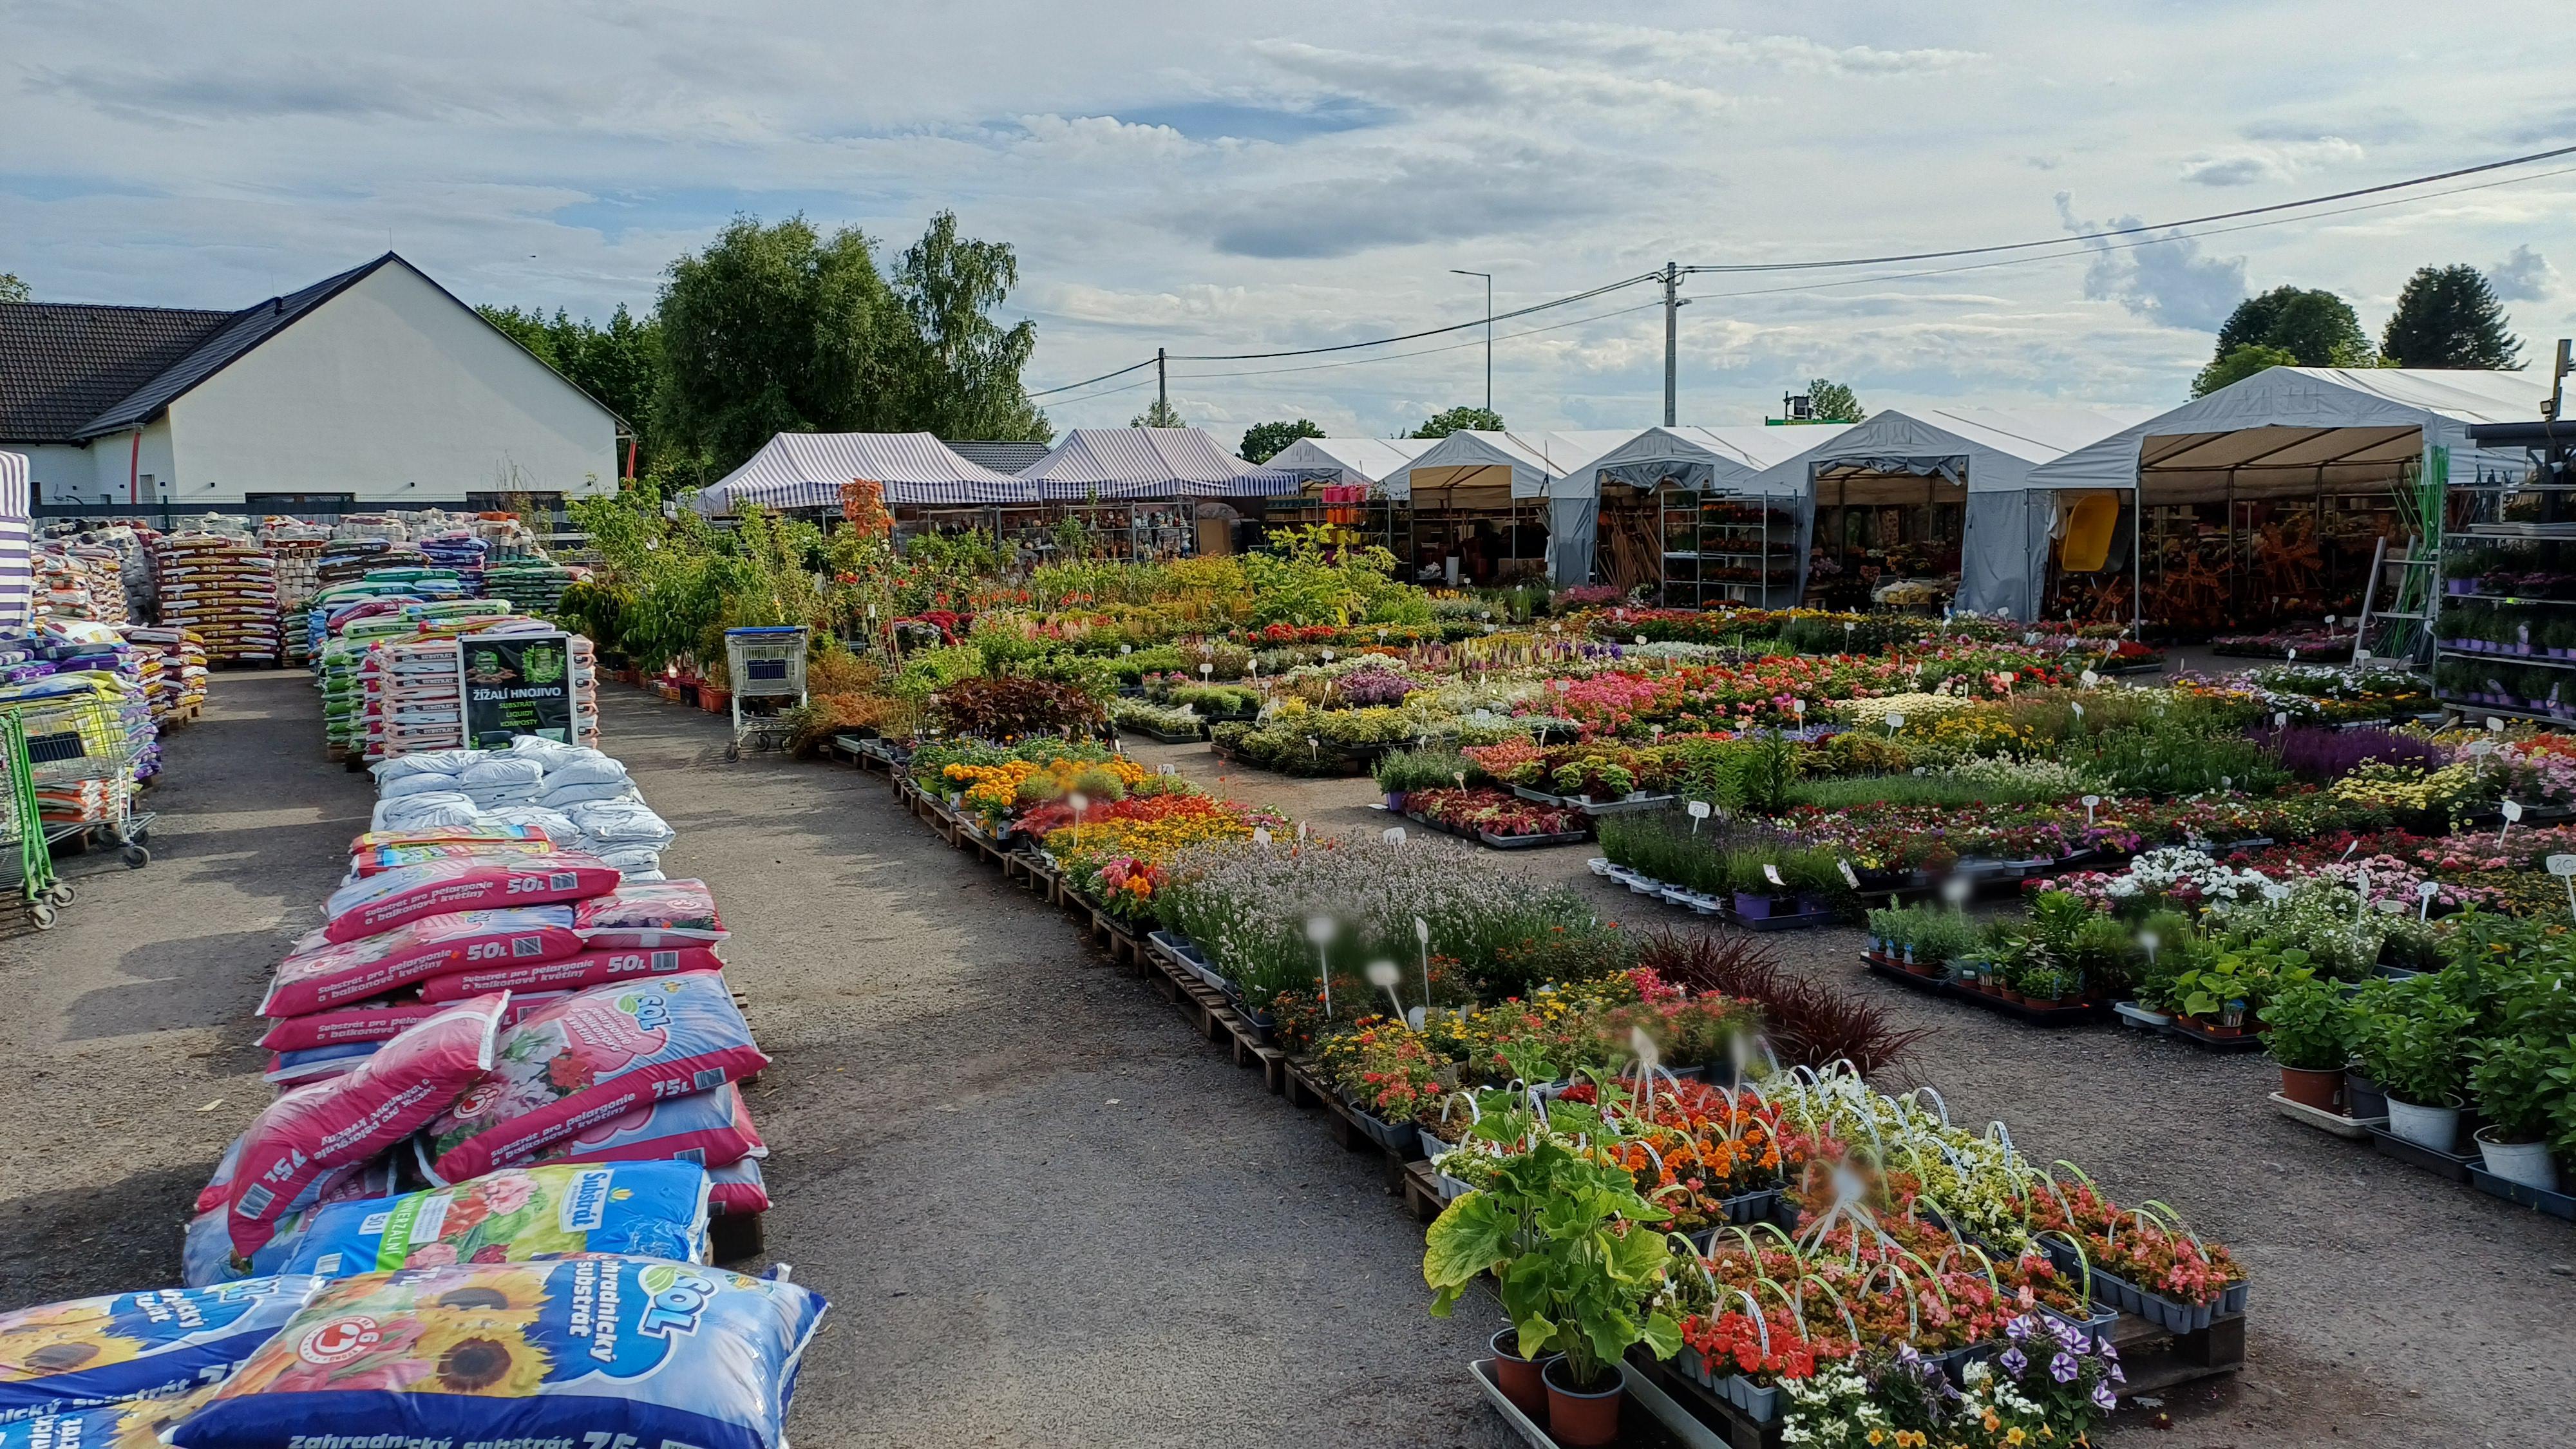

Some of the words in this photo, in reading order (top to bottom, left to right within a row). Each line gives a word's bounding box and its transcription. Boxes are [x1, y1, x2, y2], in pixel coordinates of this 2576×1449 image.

[473, 688, 508, 701] ŽÍŽALÍ
[511, 687, 562, 699] HNOJIVO
[498, 700, 538, 709] SUBSTRÁTY
[500, 719, 538, 727] KOMPOSTY
[411, 892, 428, 904] pro
[431, 881, 494, 900] pelargonie
[506, 877, 545, 894] 50L
[365, 917, 372, 925] a
[377, 898, 436, 921] balkonové
[367, 969, 384, 981] pro
[388, 949, 451, 974] pelargonie
[467, 942, 507, 961] 50L
[511, 969, 527, 978] pro
[532, 959, 595, 977] pelargonie
[607, 955, 646, 972] 50L
[318, 994, 327, 1002] a
[332, 974, 394, 999] balkonové
[399, 960, 443, 978] květiny
[368, 1019, 386, 1028] pro
[585, 1007, 632, 1045] pelargonie
[635, 995, 671, 1031] SOL
[330, 1025, 394, 1038] balkonové
[542, 1123, 562, 1137] pro
[566, 1092, 636, 1127] pelargonie
[652, 1078, 690, 1099] 75L
[492, 1158, 500, 1166] a
[571, 1173, 608, 1227] Substrát
[569, 1262, 597, 1338] substrát
[644, 1275, 715, 1336] SOL
